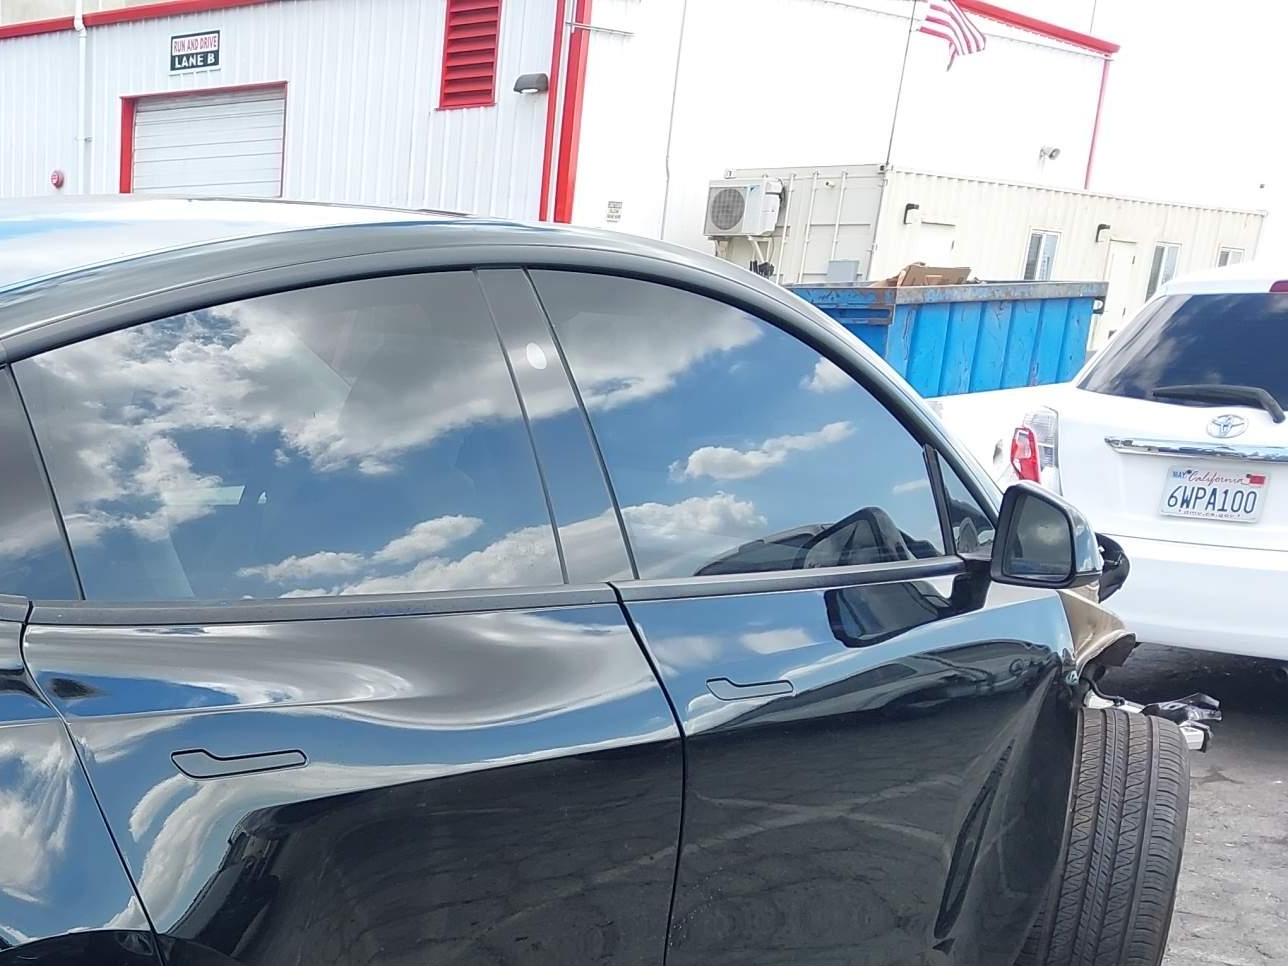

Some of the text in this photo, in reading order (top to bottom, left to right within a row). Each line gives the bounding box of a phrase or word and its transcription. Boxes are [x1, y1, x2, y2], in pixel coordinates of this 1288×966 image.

[174, 36, 217, 53] RUN AND DRIVE
[175, 52, 215, 68] LANE B
[1172, 470, 1249, 487] MAY California
[1167, 485, 1258, 514] 6WPA100
